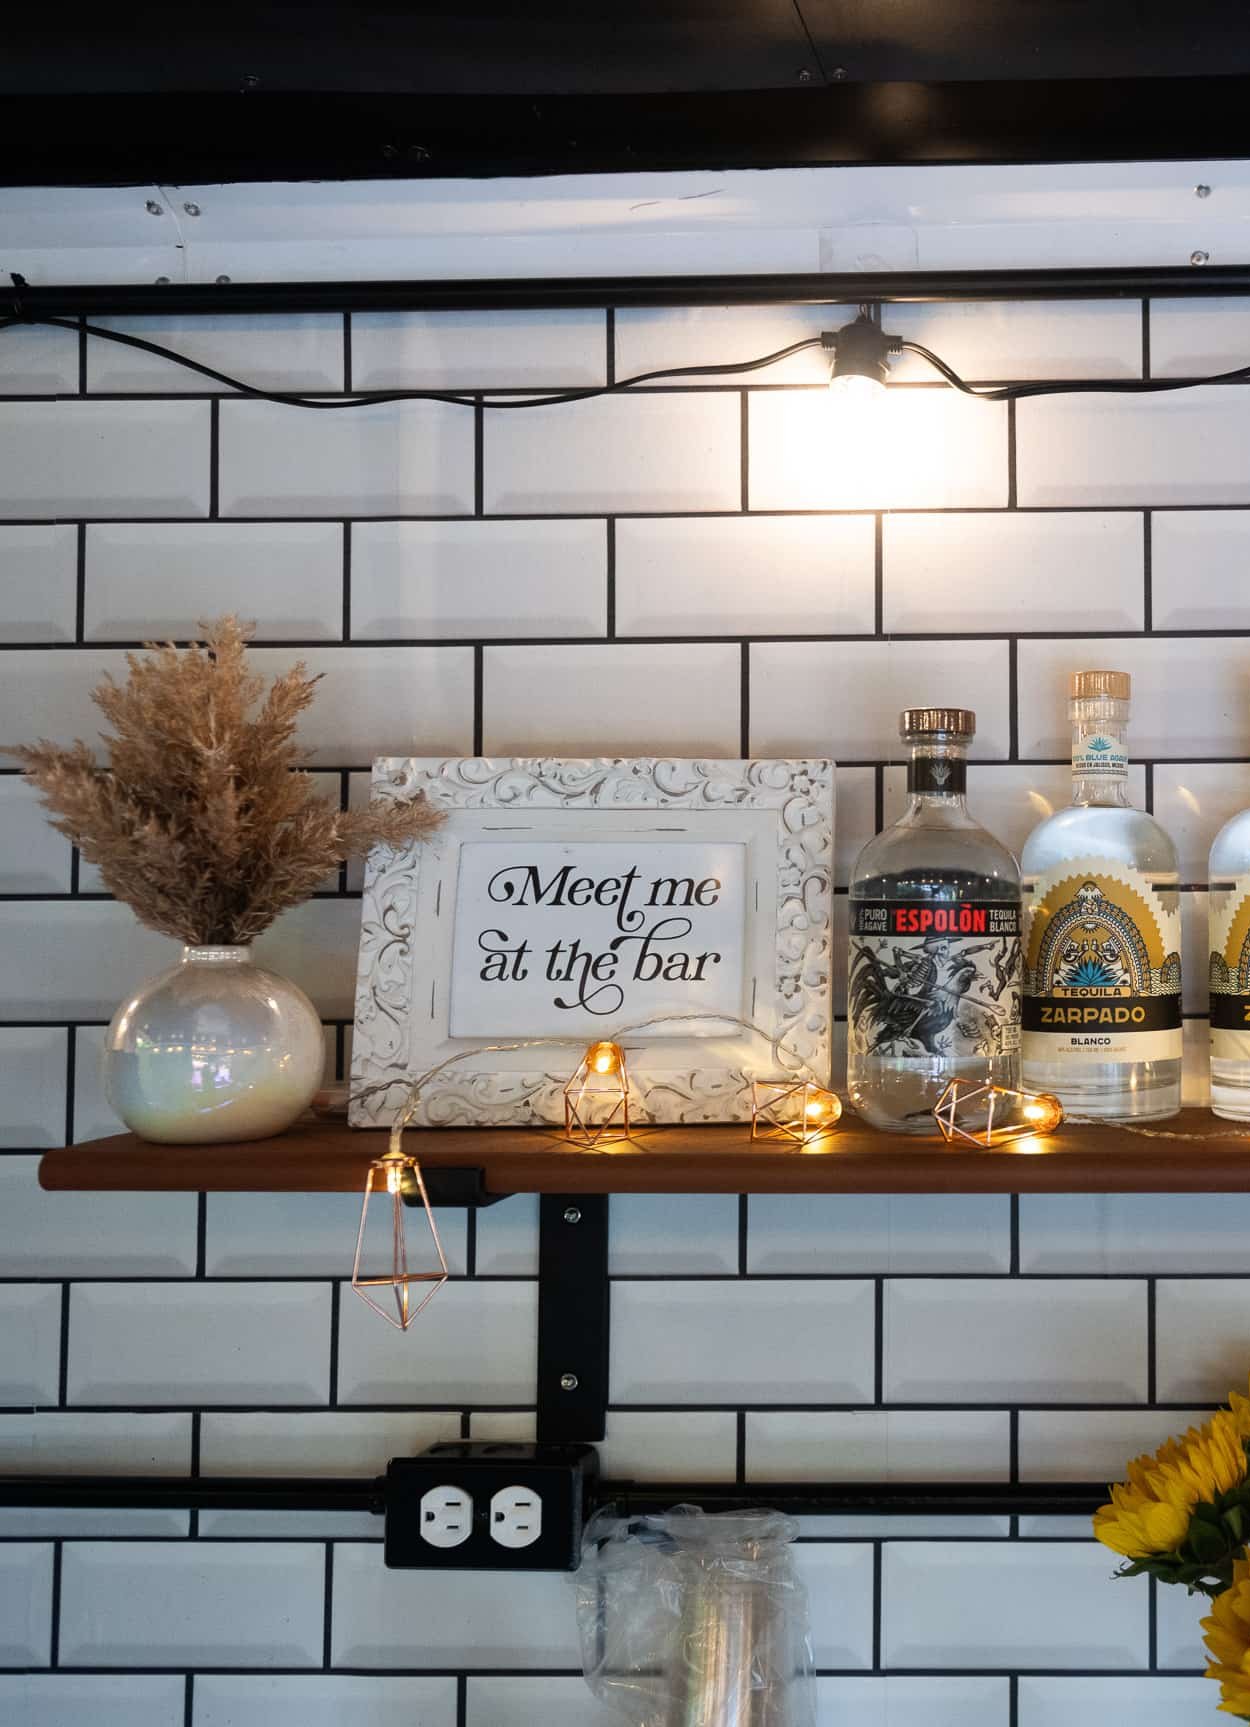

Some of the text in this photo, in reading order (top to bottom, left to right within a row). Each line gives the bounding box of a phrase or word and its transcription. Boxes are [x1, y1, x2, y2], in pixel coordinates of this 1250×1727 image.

[487, 864, 722, 932] Meet me
[864, 908, 888, 920] PURO
[989, 909, 1017, 920] TEQUILA
[864, 921, 888, 932] AGAVE
[989, 921, 1017, 932] BLANCO
[478, 917, 722, 1015] at the bar
[1061, 987, 1122, 997] TEQUILA
[1040, 1006, 1146, 1024] ZARPADO
[1070, 1037, 1112, 1045] BLANCO
